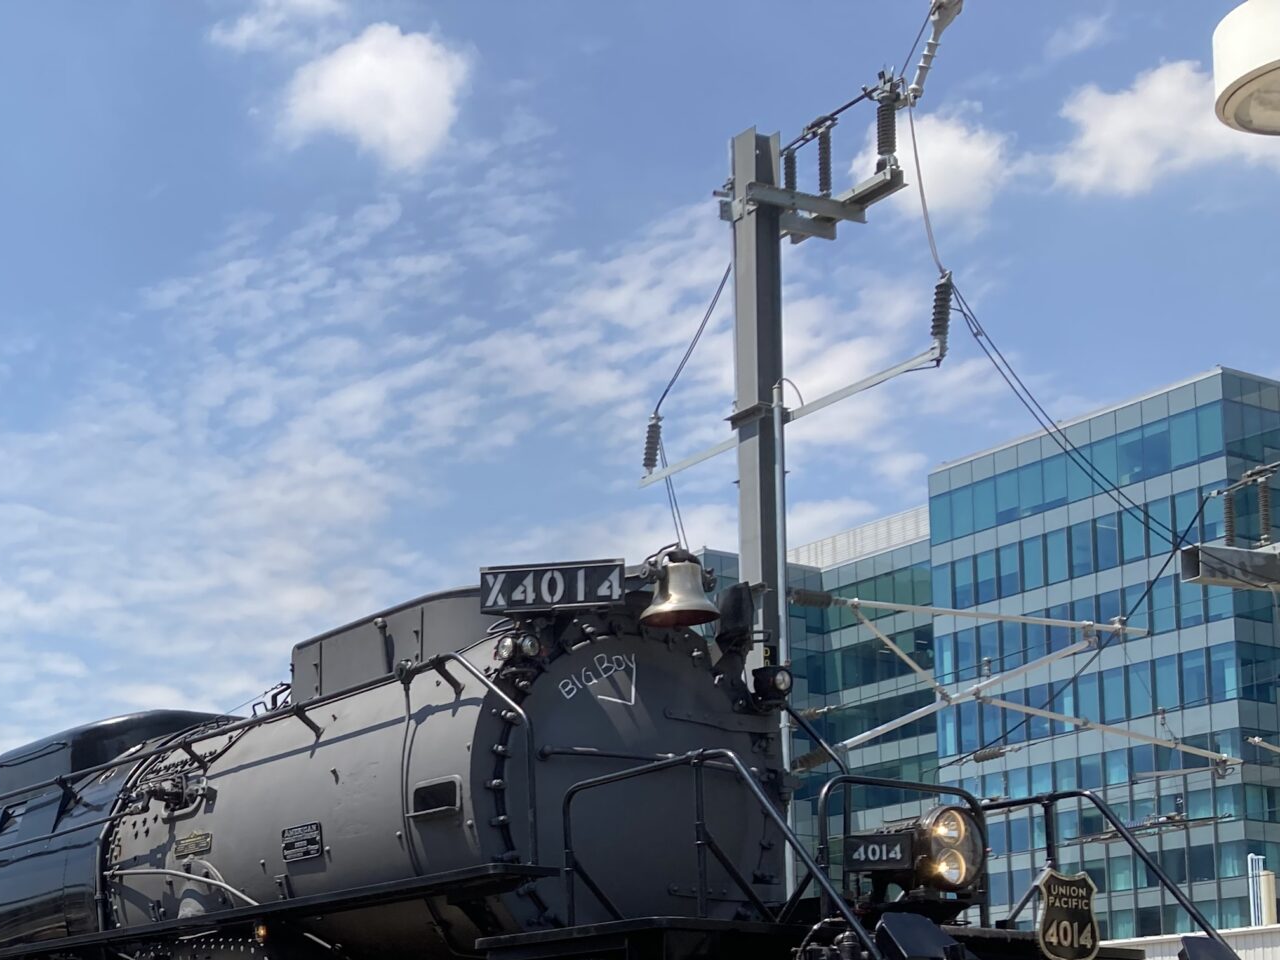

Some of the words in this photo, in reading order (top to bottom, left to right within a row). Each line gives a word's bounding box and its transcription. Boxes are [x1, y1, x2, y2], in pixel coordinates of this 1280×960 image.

[484, 566, 622, 607] X4014
[558, 667, 598, 699] BIG
[852, 843, 902, 861] 4014
[1048, 896, 1089, 910] PACIFIC
[1050, 884, 1087, 898] UNION
[1044, 919, 1093, 949] 4014
